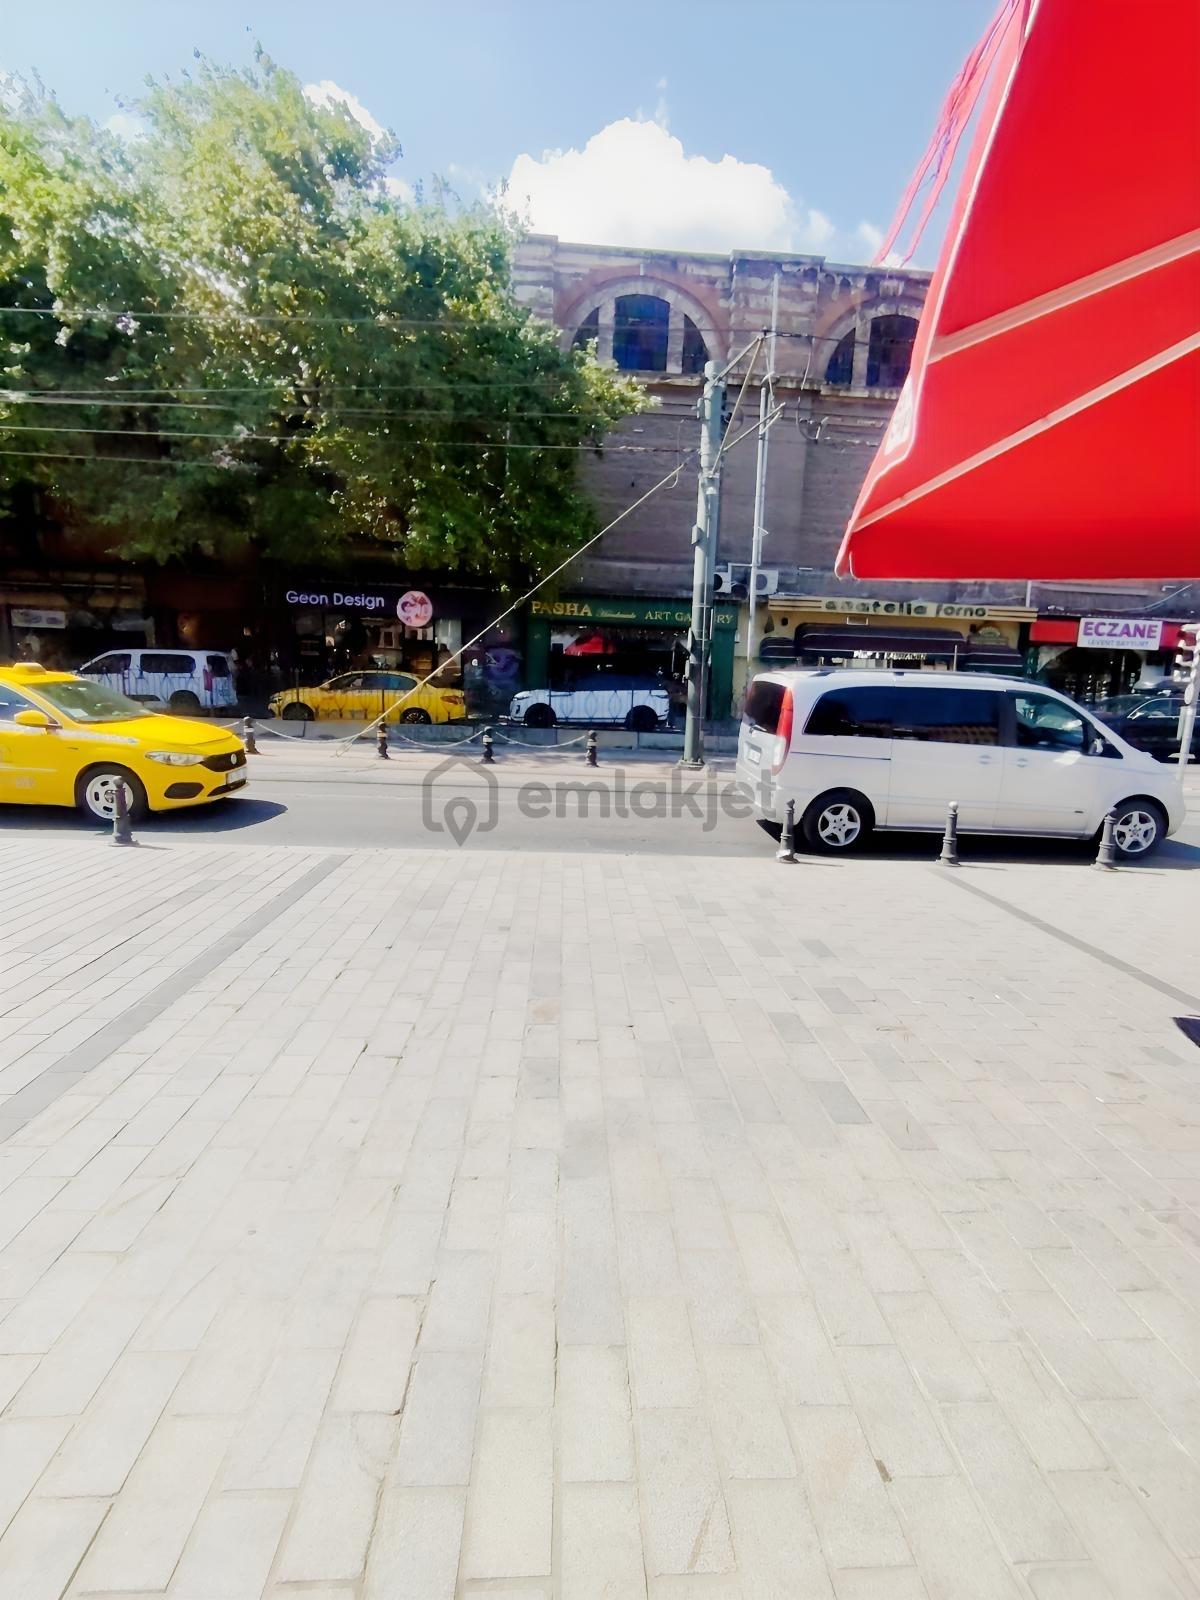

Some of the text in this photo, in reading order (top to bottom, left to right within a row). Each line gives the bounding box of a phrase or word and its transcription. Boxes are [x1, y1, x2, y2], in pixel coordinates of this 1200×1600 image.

[286, 590, 385, 609] Geon Design
[531, 601, 593, 616] PASHA
[644, 610, 671, 621] ART
[1083, 621, 1158, 639] ECZANE
